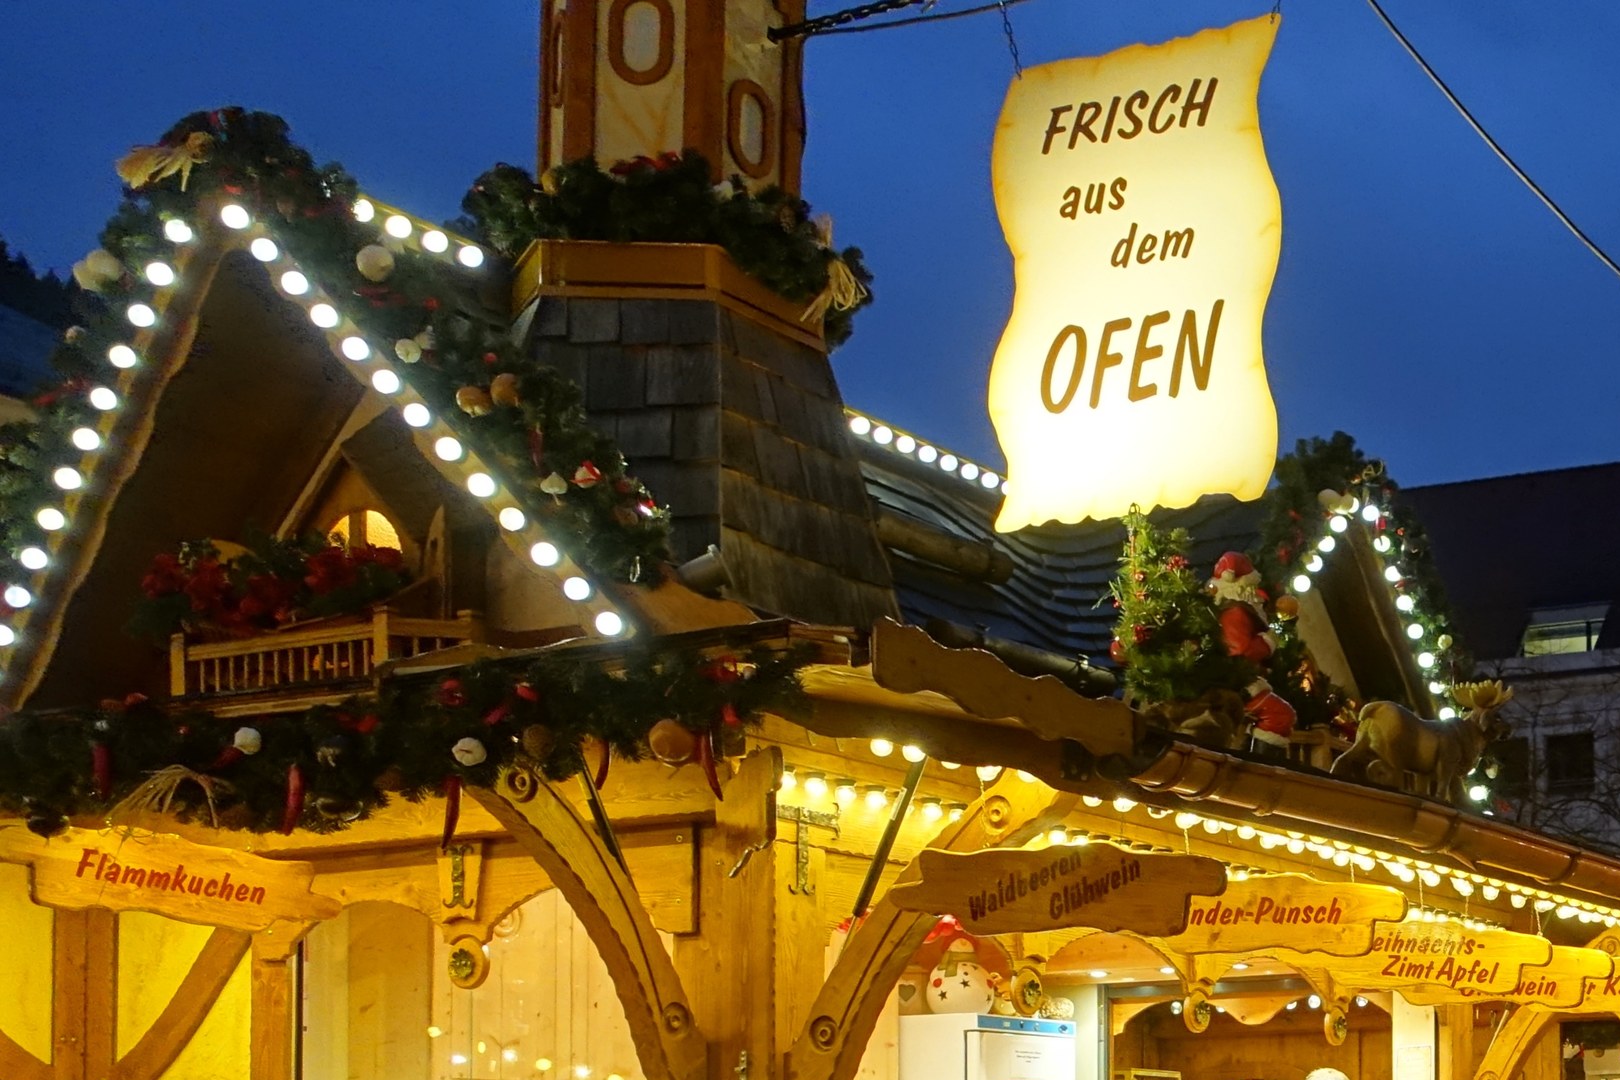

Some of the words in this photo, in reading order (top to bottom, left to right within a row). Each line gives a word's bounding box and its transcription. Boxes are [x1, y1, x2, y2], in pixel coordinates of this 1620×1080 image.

[1042, 77, 1218, 155] FRISCH
[1059, 177, 1127, 220] aus
[1111, 222, 1194, 268] dem
[1040, 299, 1225, 414] OFEN
[75, 848, 266, 905] Flammkuchen
[969, 850, 1082, 922] Waldbeeren
[1049, 857, 1142, 920] Glühwein
[1188, 896, 1342, 926] nder-Punsch
[1372, 931, 1485, 956] eihnachts-
[1381, 955, 1434, 980] Zimt
[1435, 957, 1500, 988] Apfel
